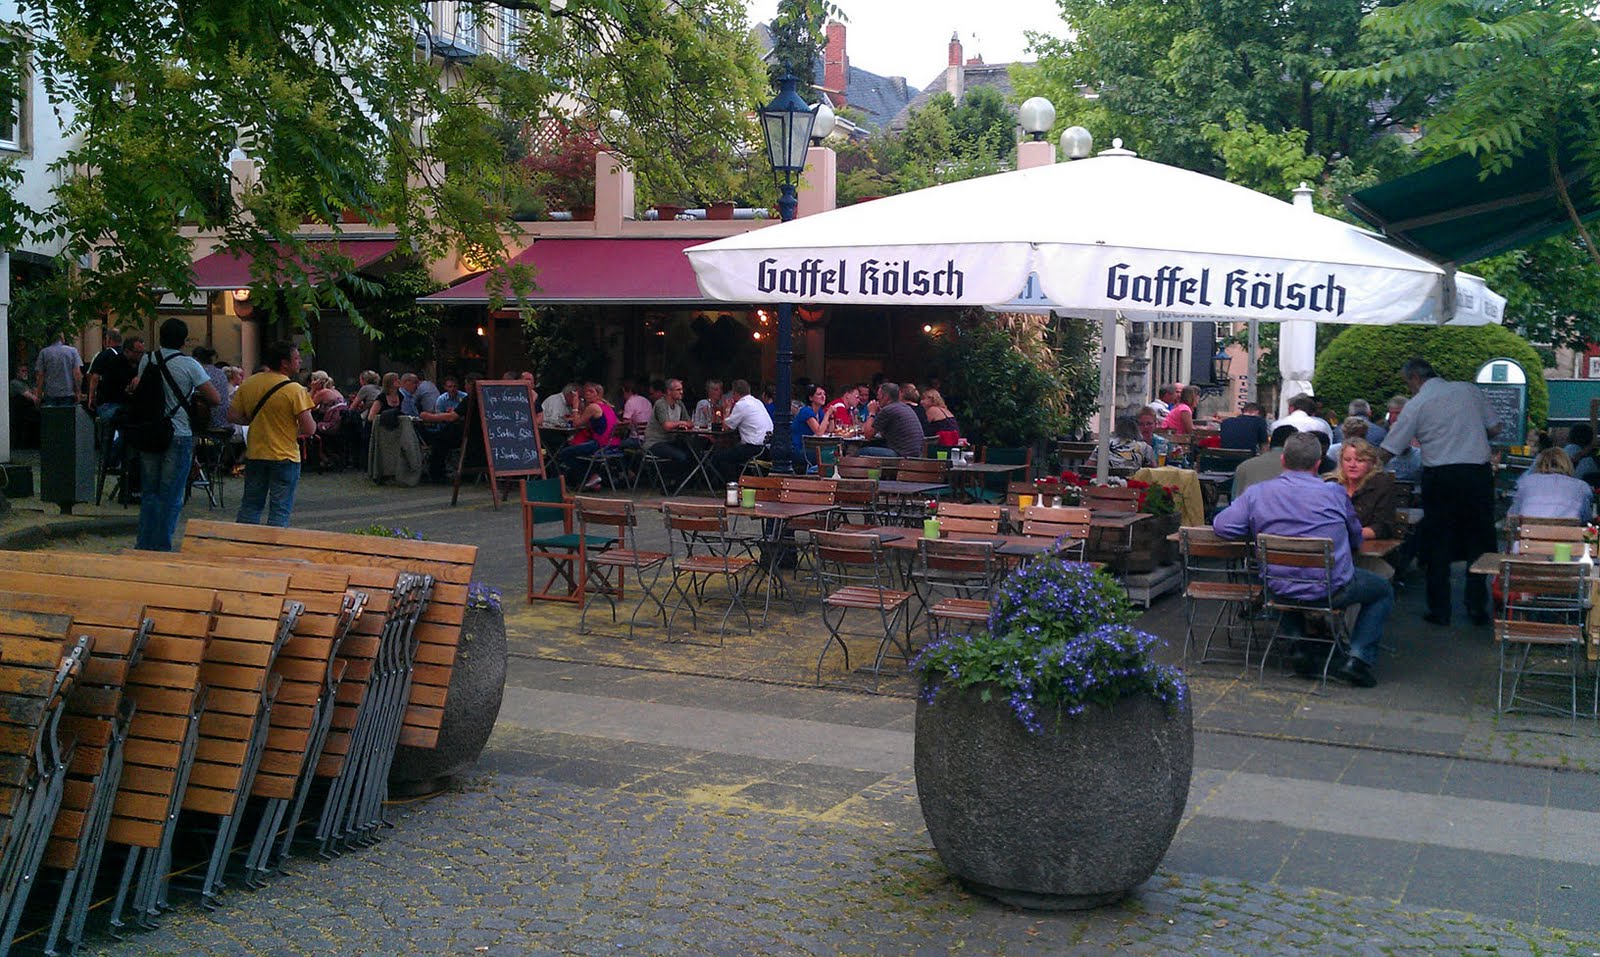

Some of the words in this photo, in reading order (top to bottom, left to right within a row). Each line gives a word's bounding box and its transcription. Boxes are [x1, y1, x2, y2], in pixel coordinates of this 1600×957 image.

[758, 257, 849, 298] Gaffel
[859, 258, 964, 300] Kölsch
[1106, 263, 1215, 308] Gaffel
[1223, 268, 1347, 318] Kölsch
